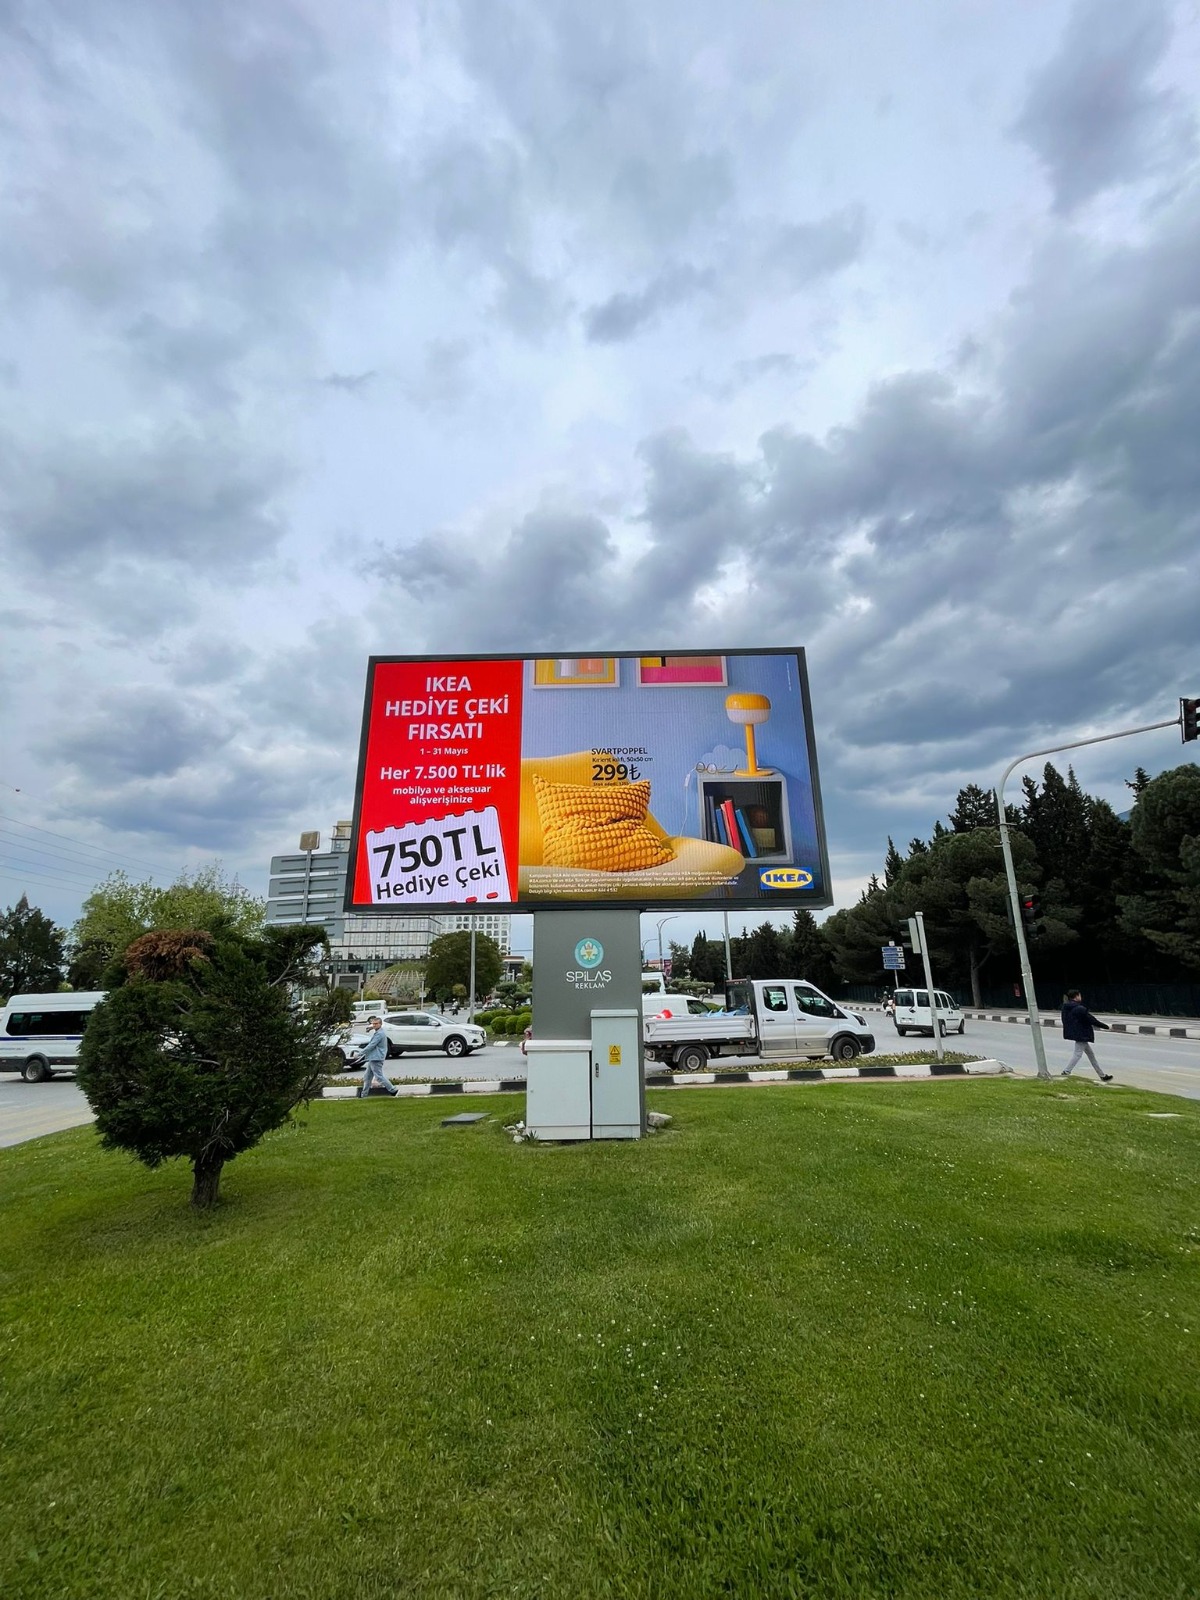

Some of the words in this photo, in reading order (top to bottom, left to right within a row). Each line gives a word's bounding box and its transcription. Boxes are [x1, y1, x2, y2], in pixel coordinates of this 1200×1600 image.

[426, 676, 472, 692] IKEA
[385, 696, 458, 717] HEDİYE
[464, 694, 509, 719] ÇEKİ
[408, 722, 483, 740] FIRSATI
[433, 747, 442, 755] 31
[444, 747, 469, 757] Mayıs
[380, 766, 410, 780] Her
[415, 765, 458, 780] 7.500
[393, 785, 432, 797] mobilya
[447, 785, 492, 794] aksesuar
[409, 794, 473, 806] alışverişinize
[376, 872, 449, 900] Hediye
[455, 859, 501, 889] Çeki
[765, 873, 809, 882] IKEA
